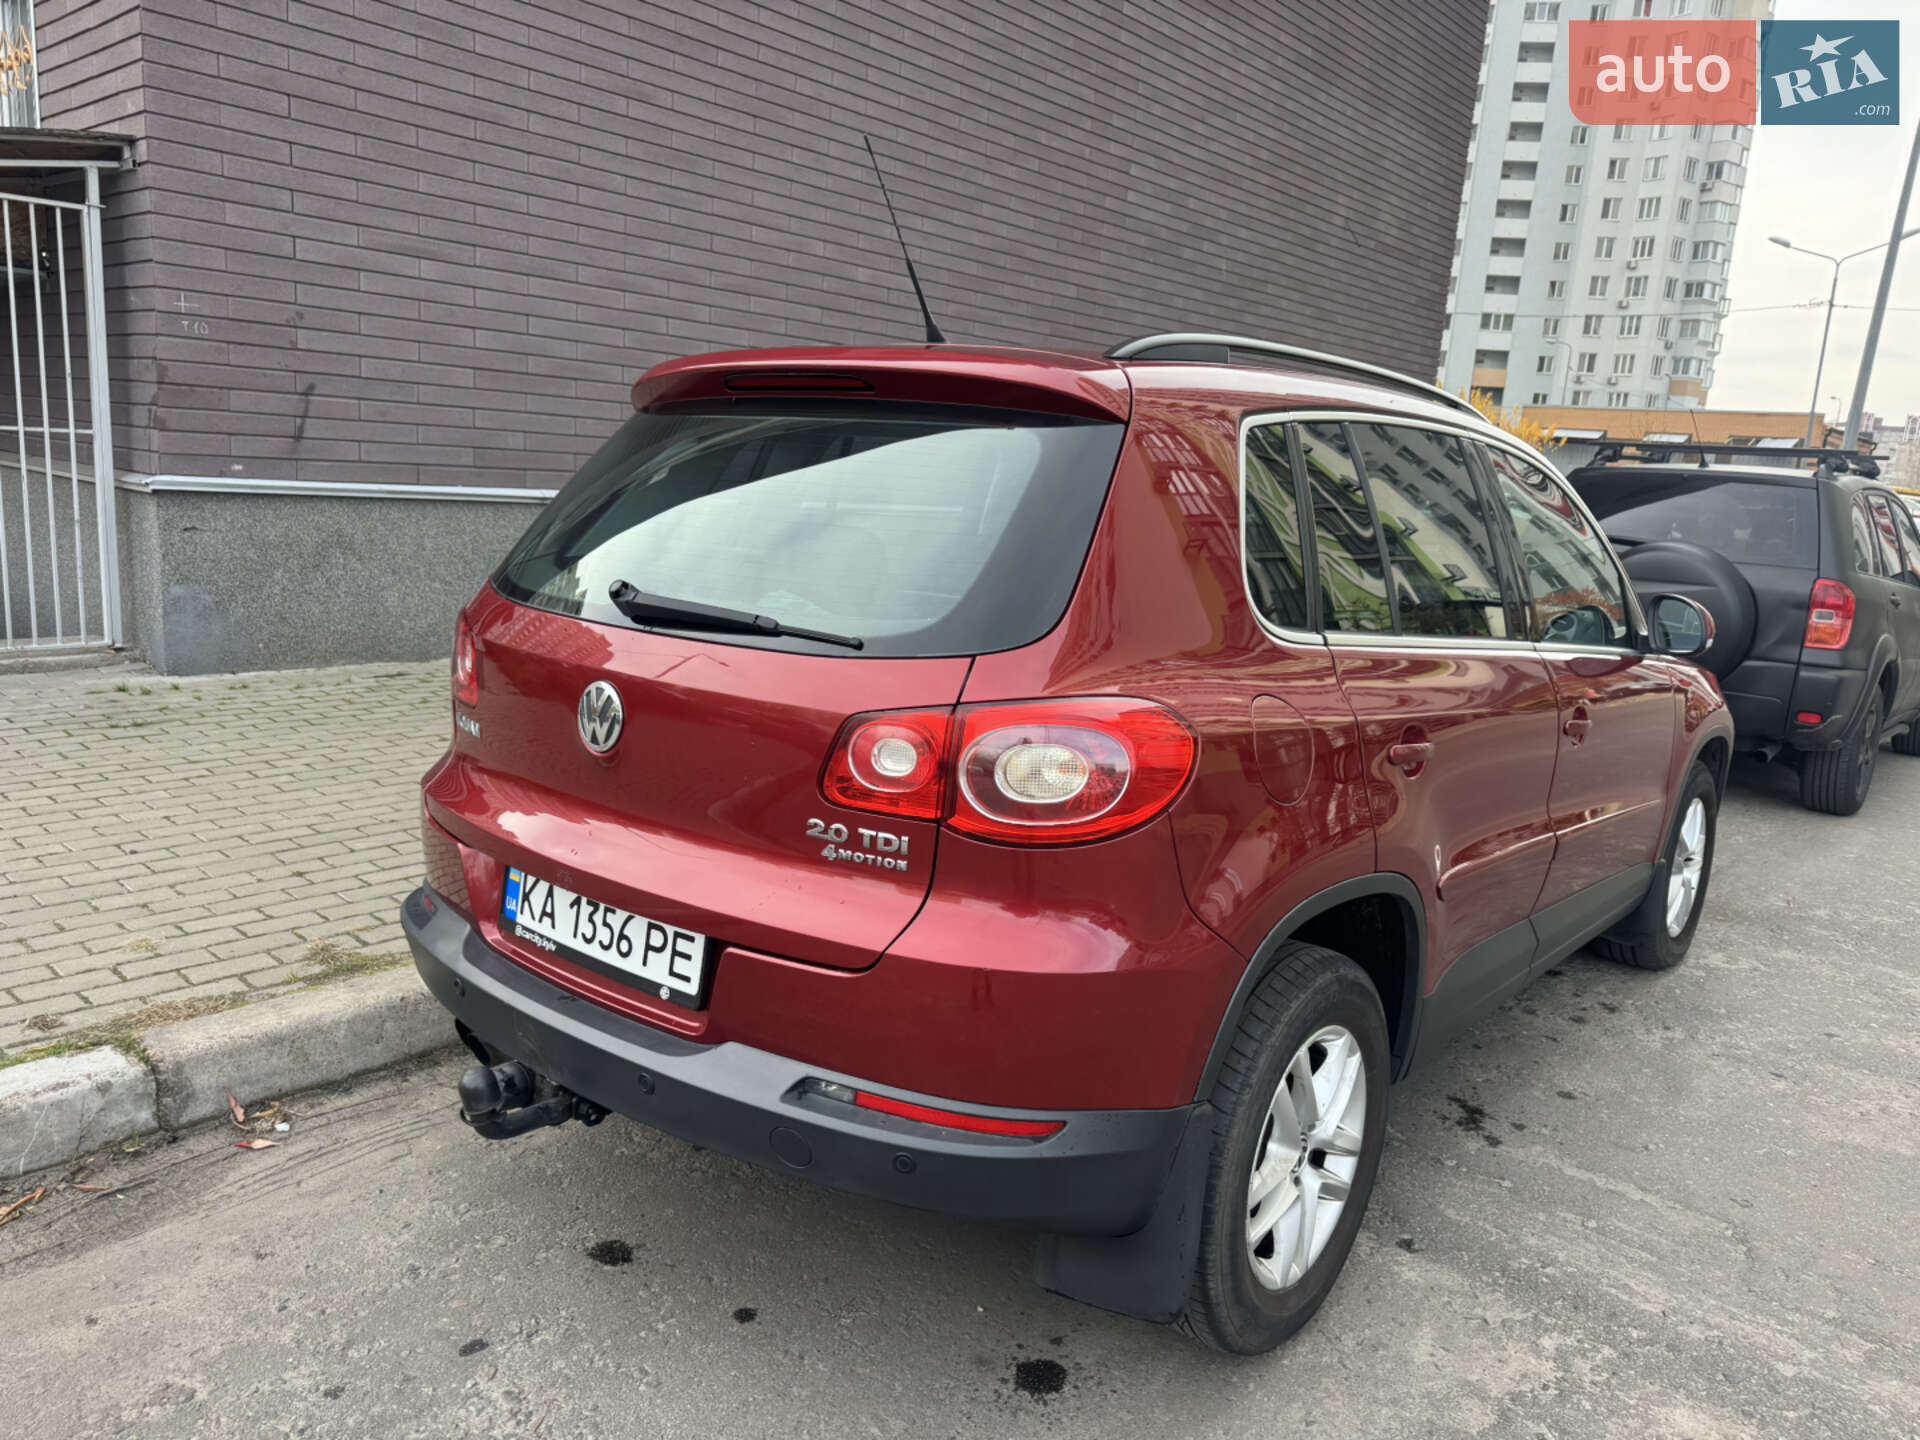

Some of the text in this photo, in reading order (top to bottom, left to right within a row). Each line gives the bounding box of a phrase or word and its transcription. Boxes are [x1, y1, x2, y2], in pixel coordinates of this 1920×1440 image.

[857, 827, 909, 856] TDI
[820, 843, 909, 872] 4MOTION
[505, 895, 517, 913] UA
[520, 872, 696, 984] KA 1356 PE
